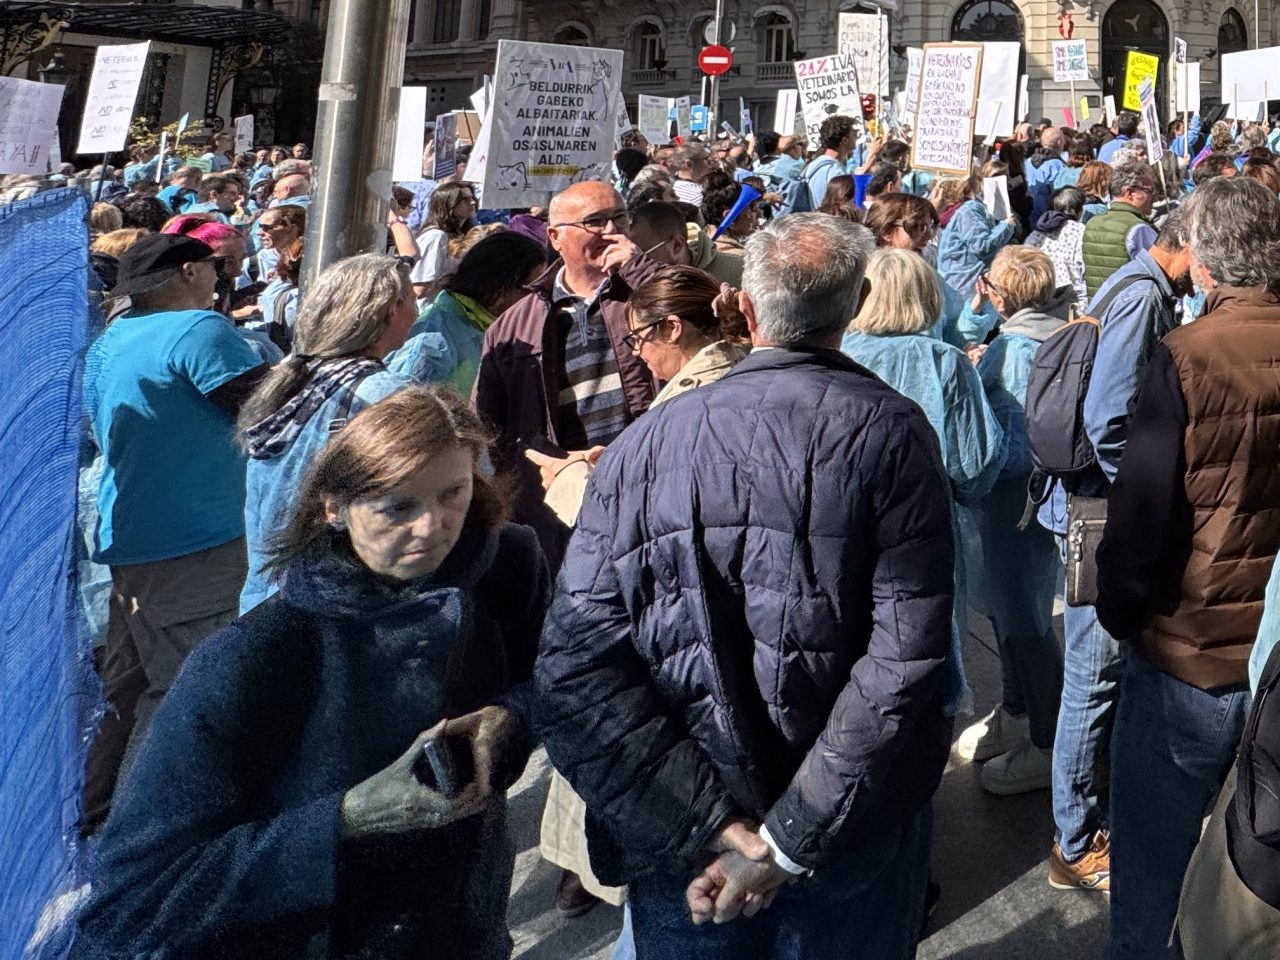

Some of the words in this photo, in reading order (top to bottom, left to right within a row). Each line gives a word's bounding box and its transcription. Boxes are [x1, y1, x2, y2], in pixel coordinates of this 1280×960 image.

[798, 58, 829, 77] 21%
[830, 54, 854, 71] IVA
[799, 71, 856, 90] VETERINARIO
[529, 81, 594, 95] BELDURRIK
[805, 87, 838, 104] SOMOS
[840, 84, 855, 96] LA
[537, 95, 584, 107] GABEKO
[516, 108, 599, 122] ALBAITARIAK,
[522, 125, 590, 138] ANIMALIEN
[512, 139, 596, 151] OSASUNAREN
[538, 154, 571, 165] ALDE
